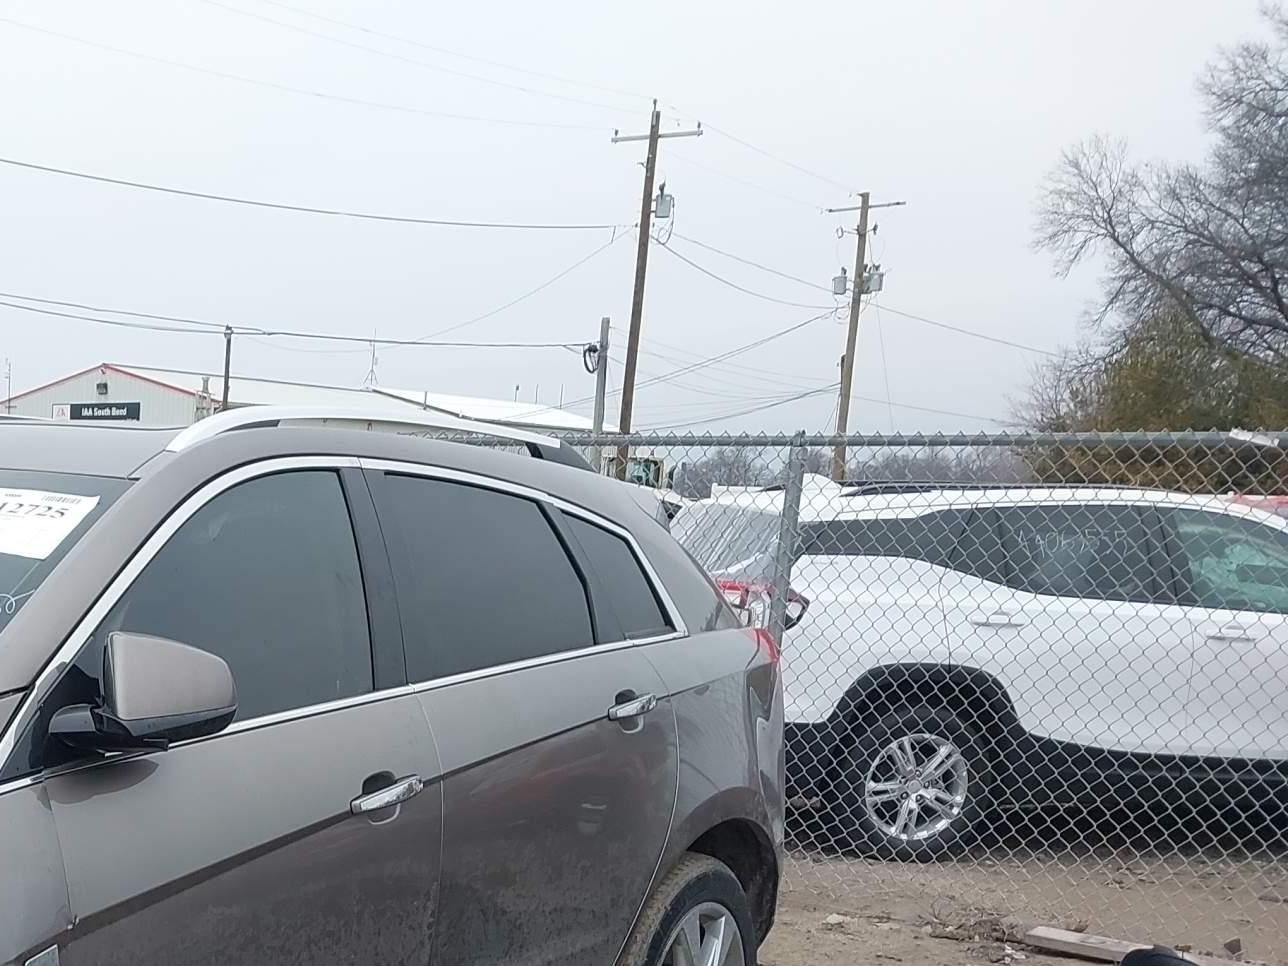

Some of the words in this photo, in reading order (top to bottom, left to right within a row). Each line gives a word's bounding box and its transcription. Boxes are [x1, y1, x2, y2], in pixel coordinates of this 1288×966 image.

[81, 407, 92, 417] IAA
[94, 406, 111, 417] South
[112, 406, 127, 416] Bend
